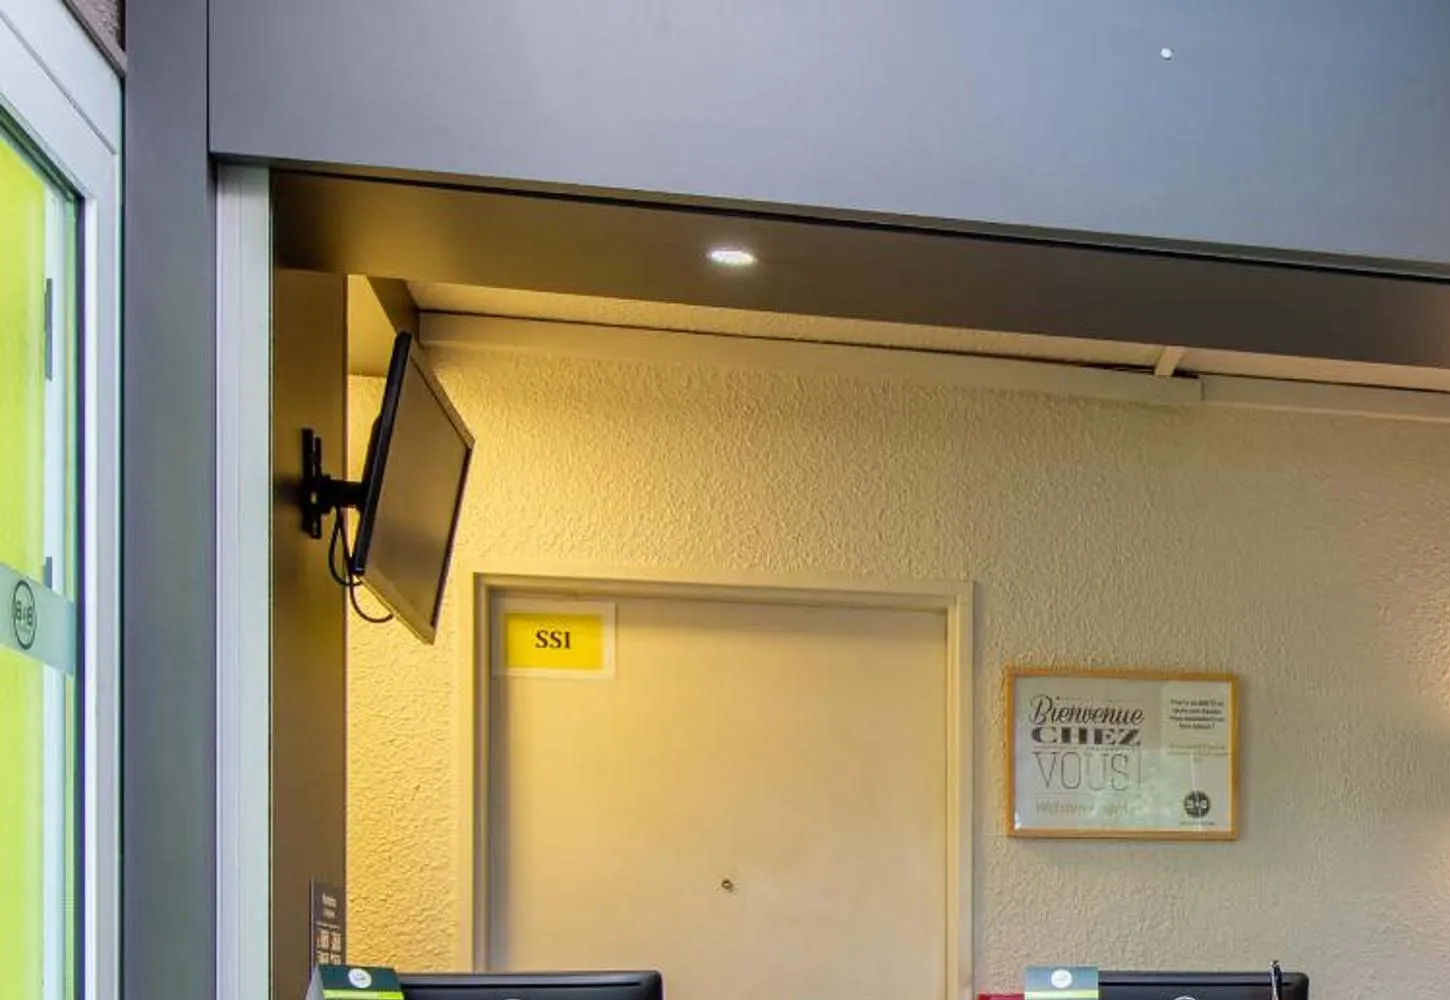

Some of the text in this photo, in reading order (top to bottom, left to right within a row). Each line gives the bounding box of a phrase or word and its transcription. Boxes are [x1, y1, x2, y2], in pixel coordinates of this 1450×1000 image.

[535, 630, 572, 649] SSI
[1029, 694, 1145, 725] Bienvenue
[1031, 727, 1141, 745] CHEZ
